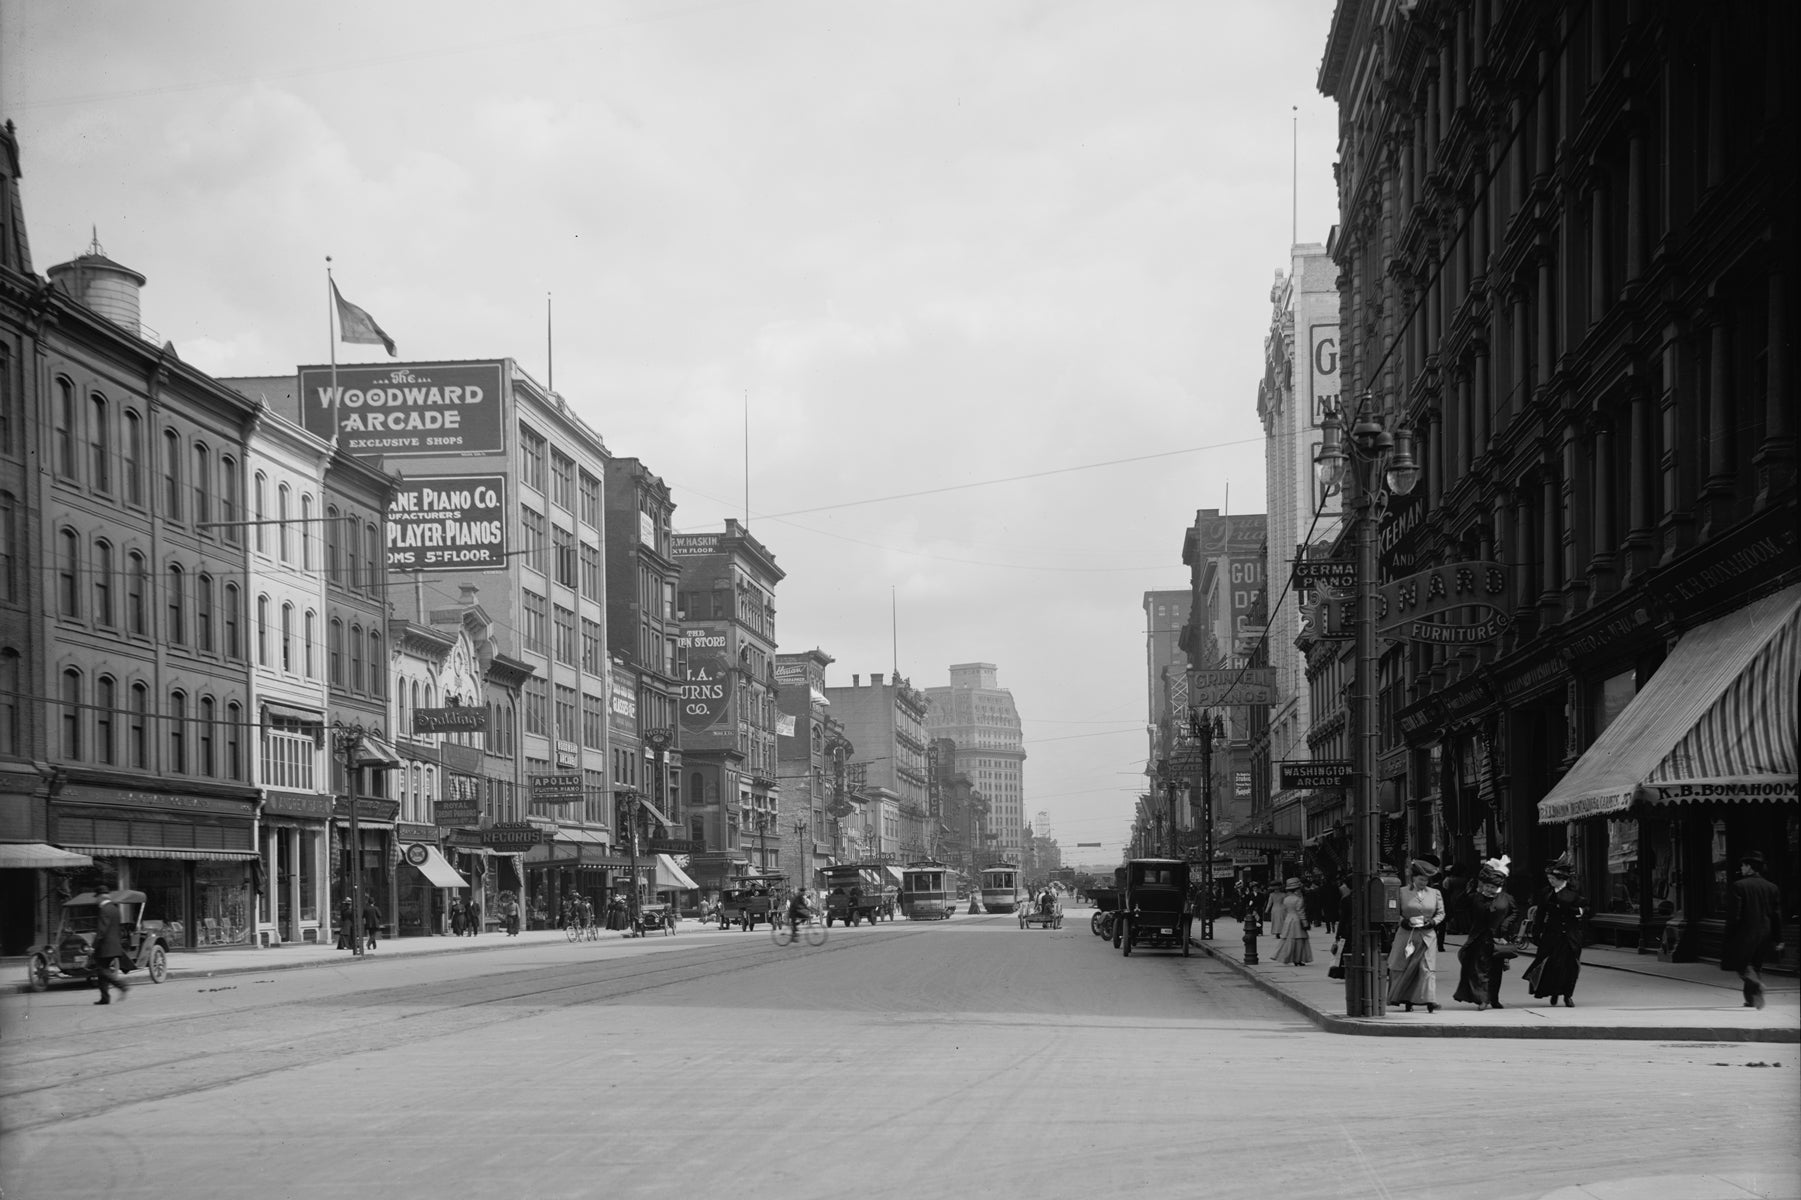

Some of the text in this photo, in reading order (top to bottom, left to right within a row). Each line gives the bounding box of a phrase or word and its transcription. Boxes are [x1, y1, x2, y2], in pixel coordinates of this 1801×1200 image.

[1315, 338, 1338, 375] G
[391, 369, 417, 384] The
[317, 385, 485, 409] WOODWARD
[341, 410, 462, 432] ARCADE
[349, 435, 464, 448] EXCLUSIVE SHOPS
[423, 488, 471, 511] PIANO
[387, 520, 502, 548] PLAYER-PIANOS
[1377, 498, 1424, 560] KEENAN
[689, 545, 716, 556] FLOOR.
[1392, 553, 1415, 567] AND
[1296, 564, 1358, 576] GERMA
[686, 630, 705, 638] THE
[1411, 622, 1497, 642] FURNITURE
[694, 636, 726, 648] STORE
[1194, 672, 1272, 690] GRINNELL
[1199, 691, 1268, 705] PIANOS
[686, 703, 710, 715] CO.
[416, 712, 485, 731] Spalding's
[1283, 765, 1353, 777] WASHINGTON
[534, 776, 580, 787] APOLLO
[1296, 777, 1342, 787] ARCADE
[443, 802, 468, 810] ROYAL
[482, 830, 540, 844] RECORDS
